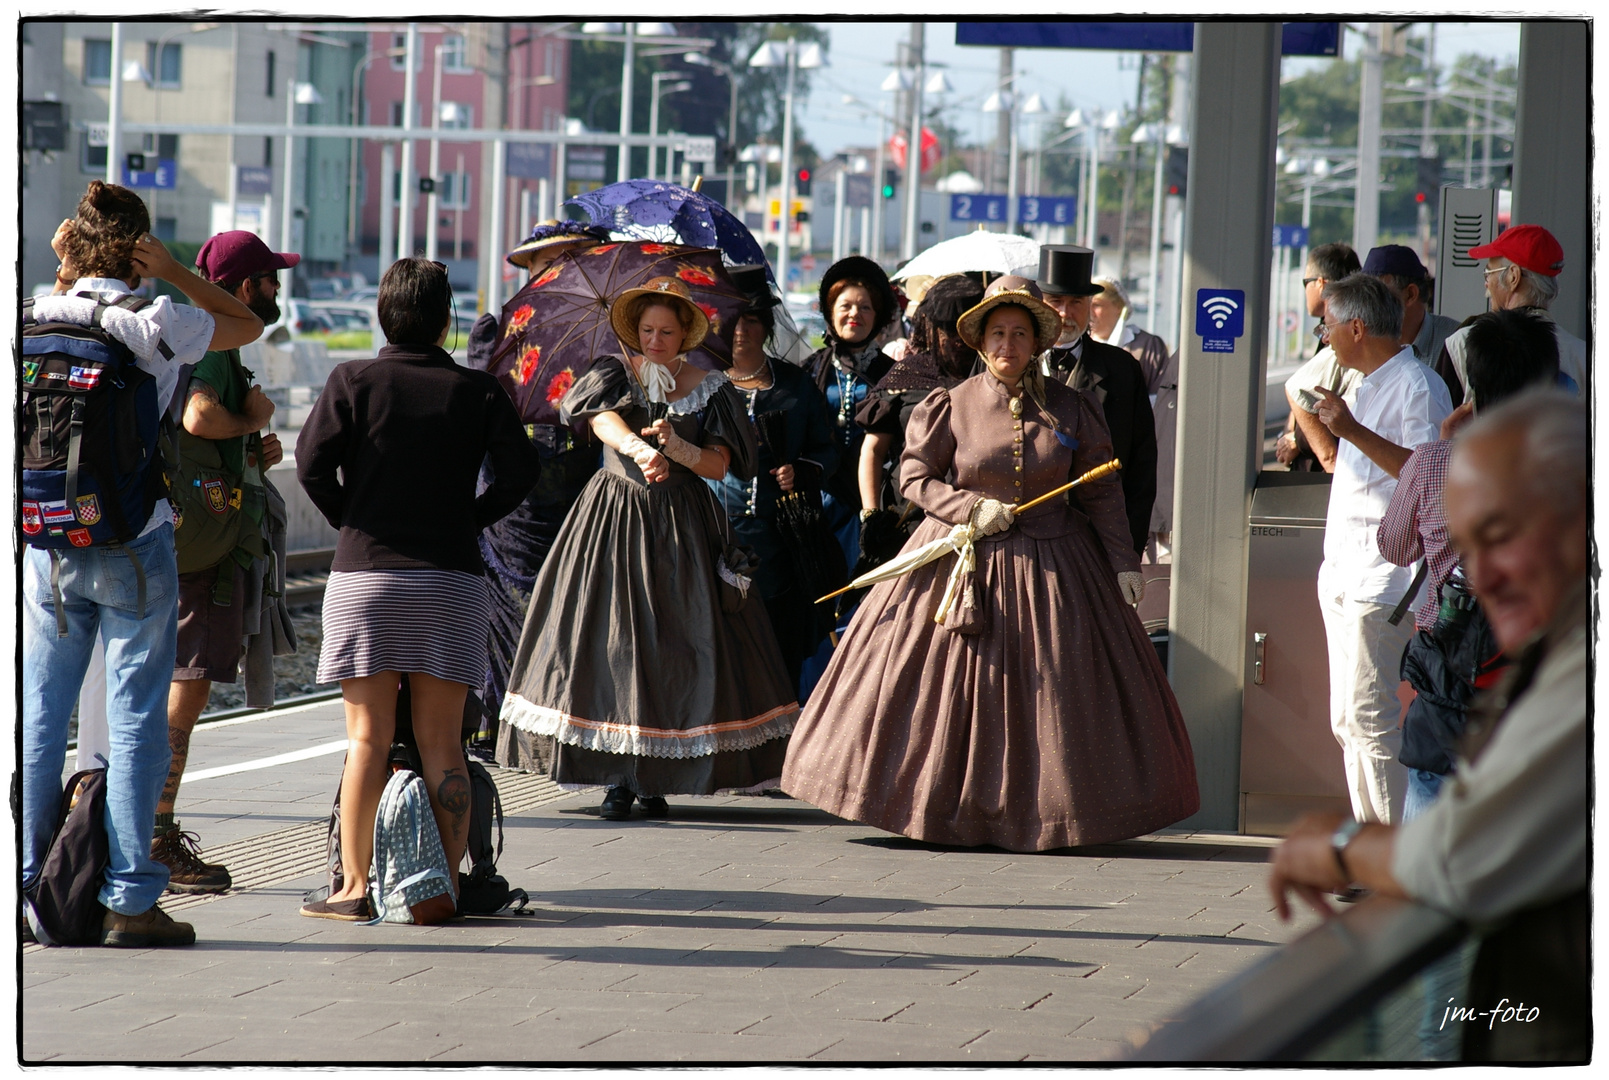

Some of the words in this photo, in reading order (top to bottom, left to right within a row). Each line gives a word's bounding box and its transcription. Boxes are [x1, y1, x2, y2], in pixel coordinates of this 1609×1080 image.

[155, 166, 167, 186] E
[956, 195, 972, 219] 2
[986, 200, 999, 220] E
[1023, 198, 1039, 221] 3
[1054, 203, 1067, 223] E
[1251, 526, 1283, 536] ETECH
